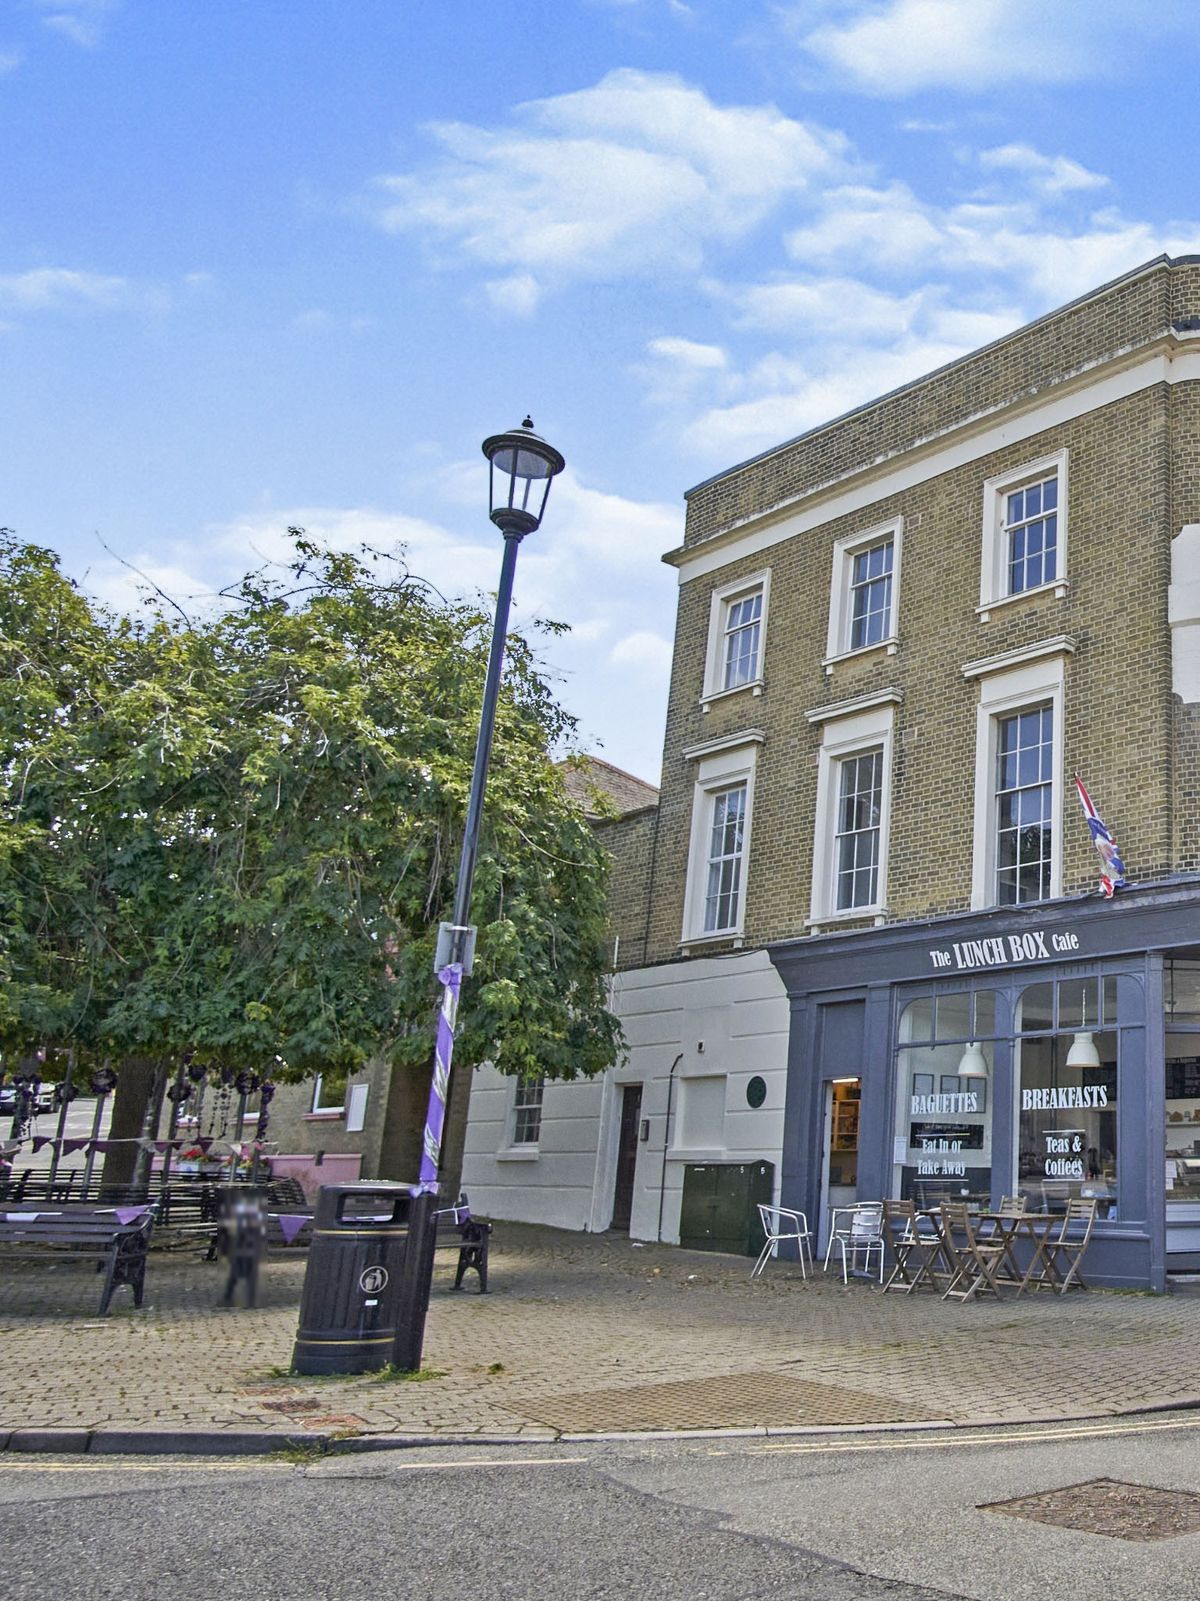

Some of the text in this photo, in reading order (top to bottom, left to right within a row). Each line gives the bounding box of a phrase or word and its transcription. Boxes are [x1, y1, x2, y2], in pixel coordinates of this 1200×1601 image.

[930, 931, 1079, 969] The LUNCH BOX Cafe
[911, 1092, 978, 1115] BAGUETTES
[1021, 1085, 1108, 1110] BREAKFASTS
[922, 1138, 937, 1154] Eat
[939, 1138, 949, 1154] In
[951, 1140, 962, 1154] or
[1046, 1135, 1082, 1154] Teas &
[917, 1160, 967, 1177] Take Away
[1044, 1158, 1083, 1176] Coffees
